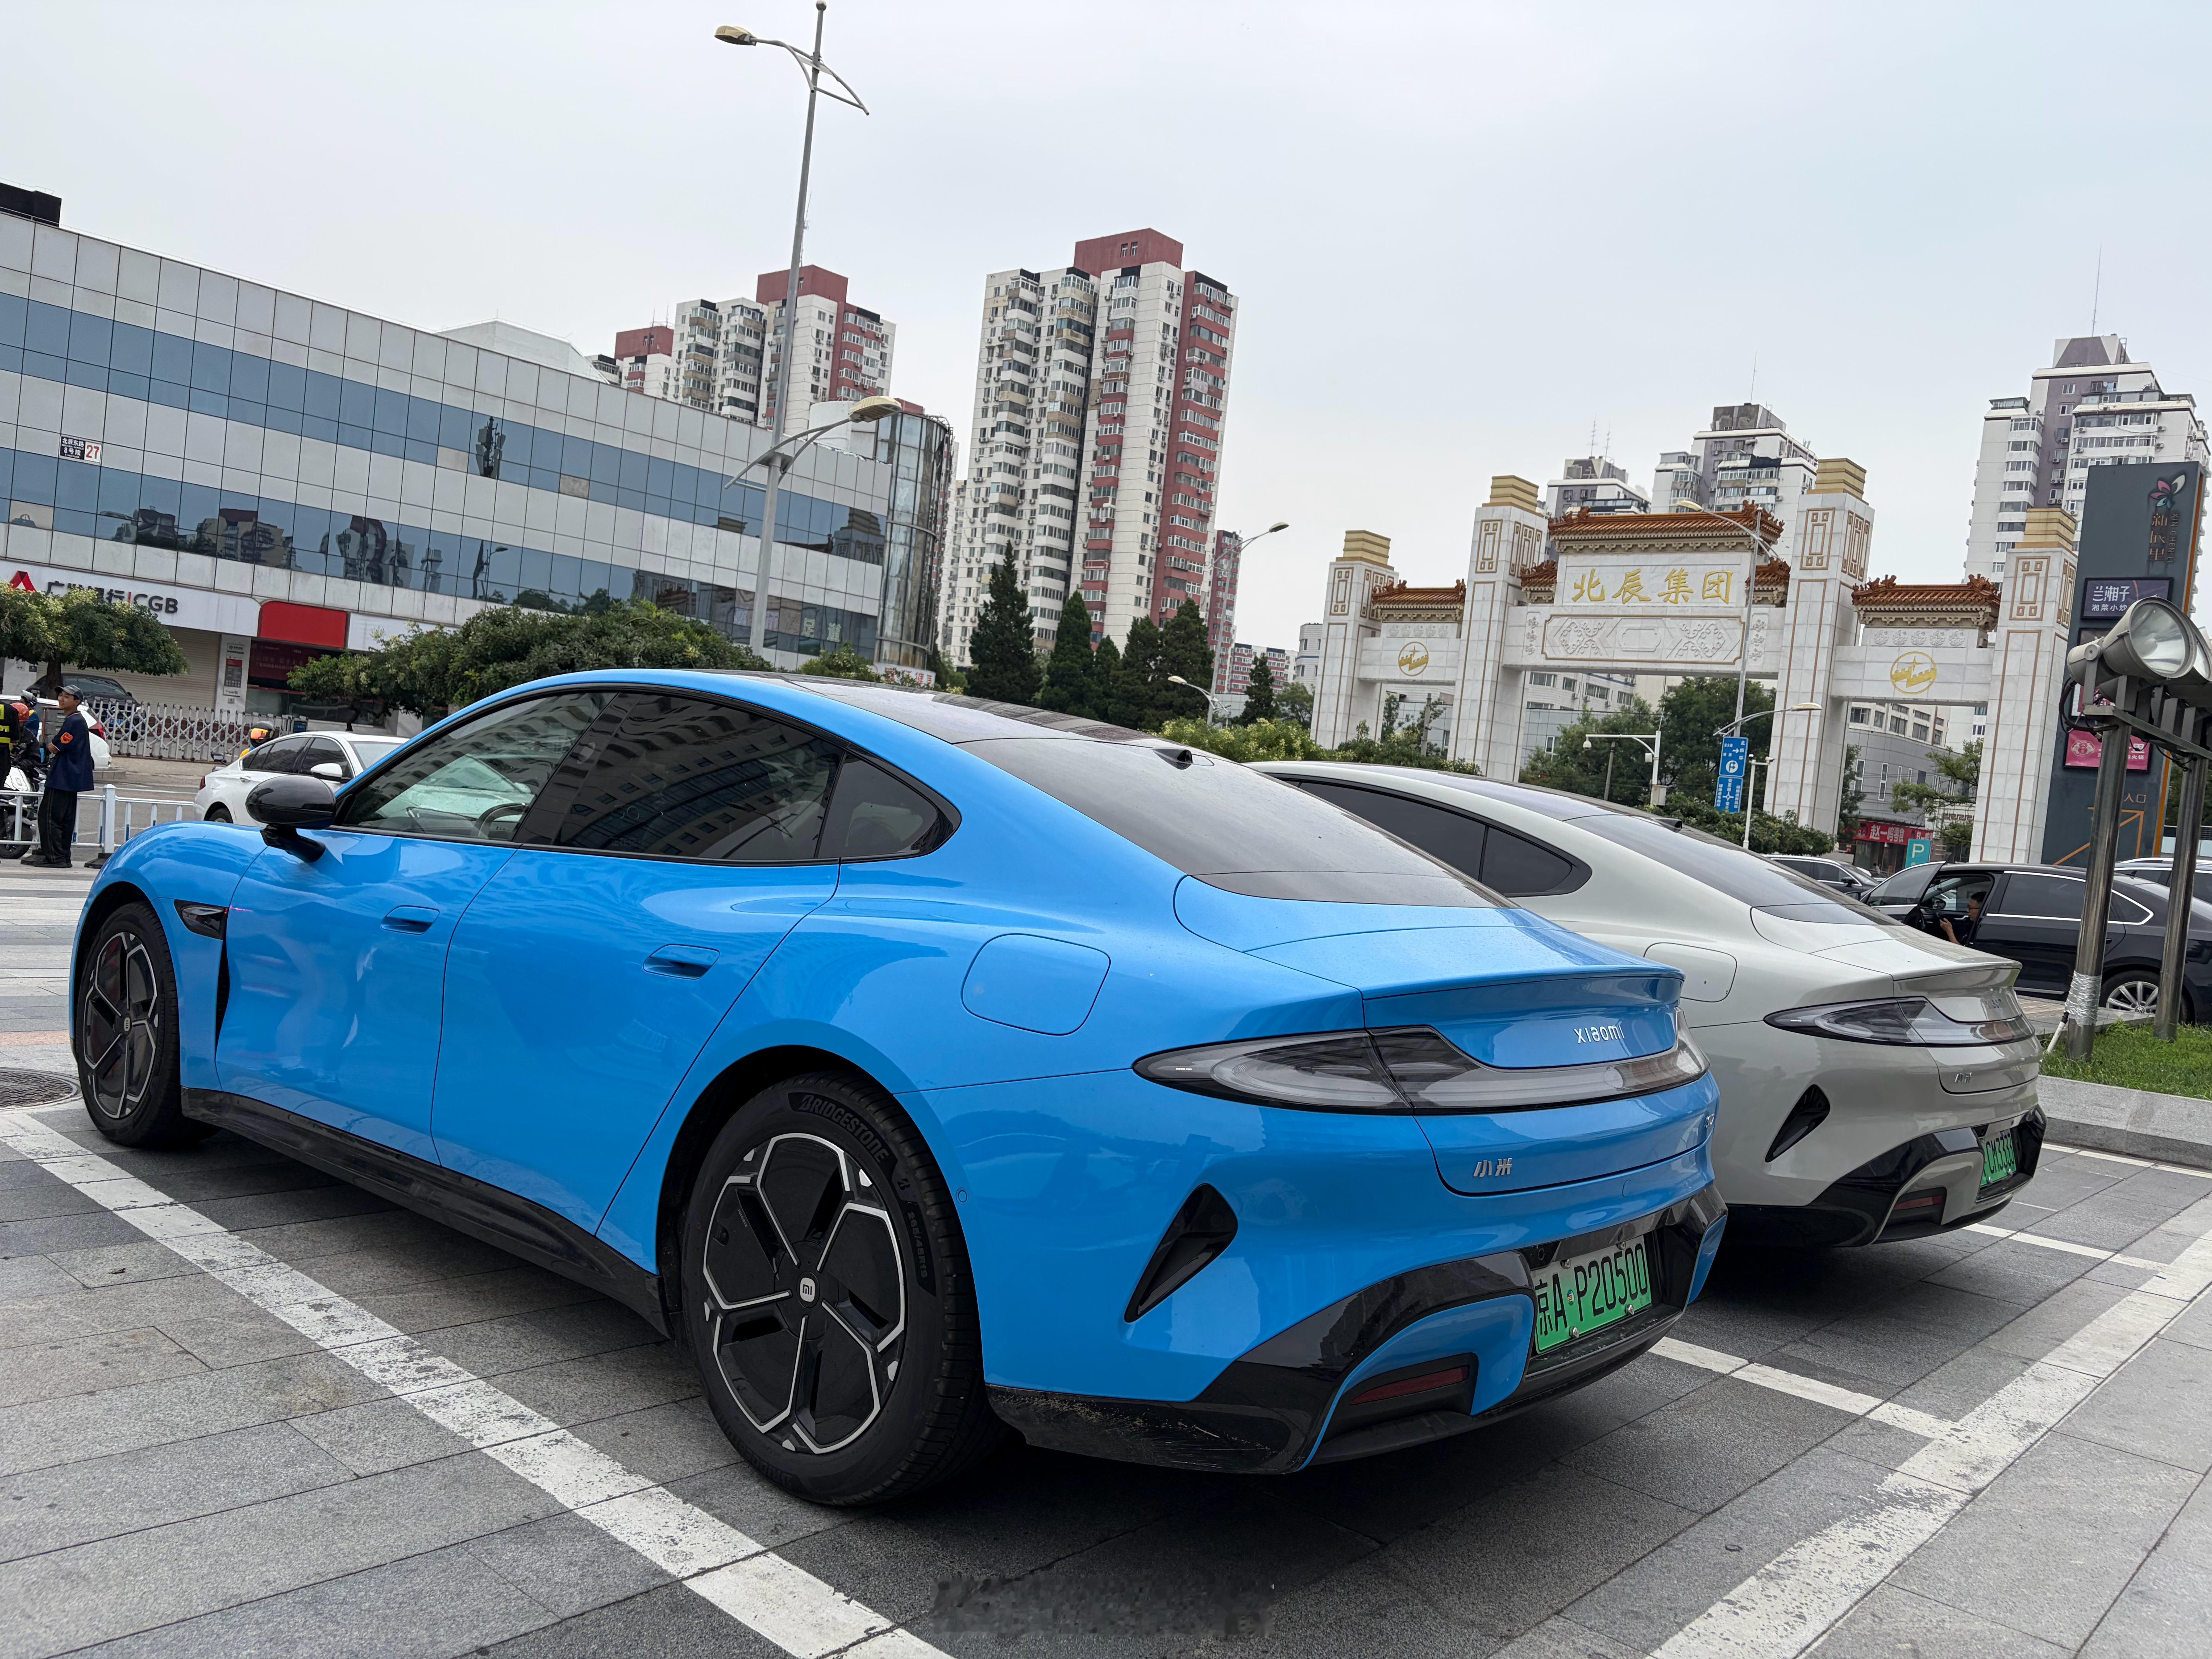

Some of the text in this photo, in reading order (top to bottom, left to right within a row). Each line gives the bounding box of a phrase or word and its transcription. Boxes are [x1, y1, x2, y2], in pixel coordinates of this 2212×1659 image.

[86, 445, 100, 459] 27
[2168, 531, 2177, 553] CHEN
[1571, 567, 1733, 605] 北辰集团
[2093, 585, 2130, 602] 兰湘子
[2123, 793, 2146, 803] 入口
[1869, 824, 1905, 843] 赵一鸣零食
[1912, 843, 1925, 858] P
[799, 1094, 890, 1162] BRIDGESTONE
[1984, 1133, 2014, 1176] CM3333
[1473, 1158, 1512, 1178] 小米
